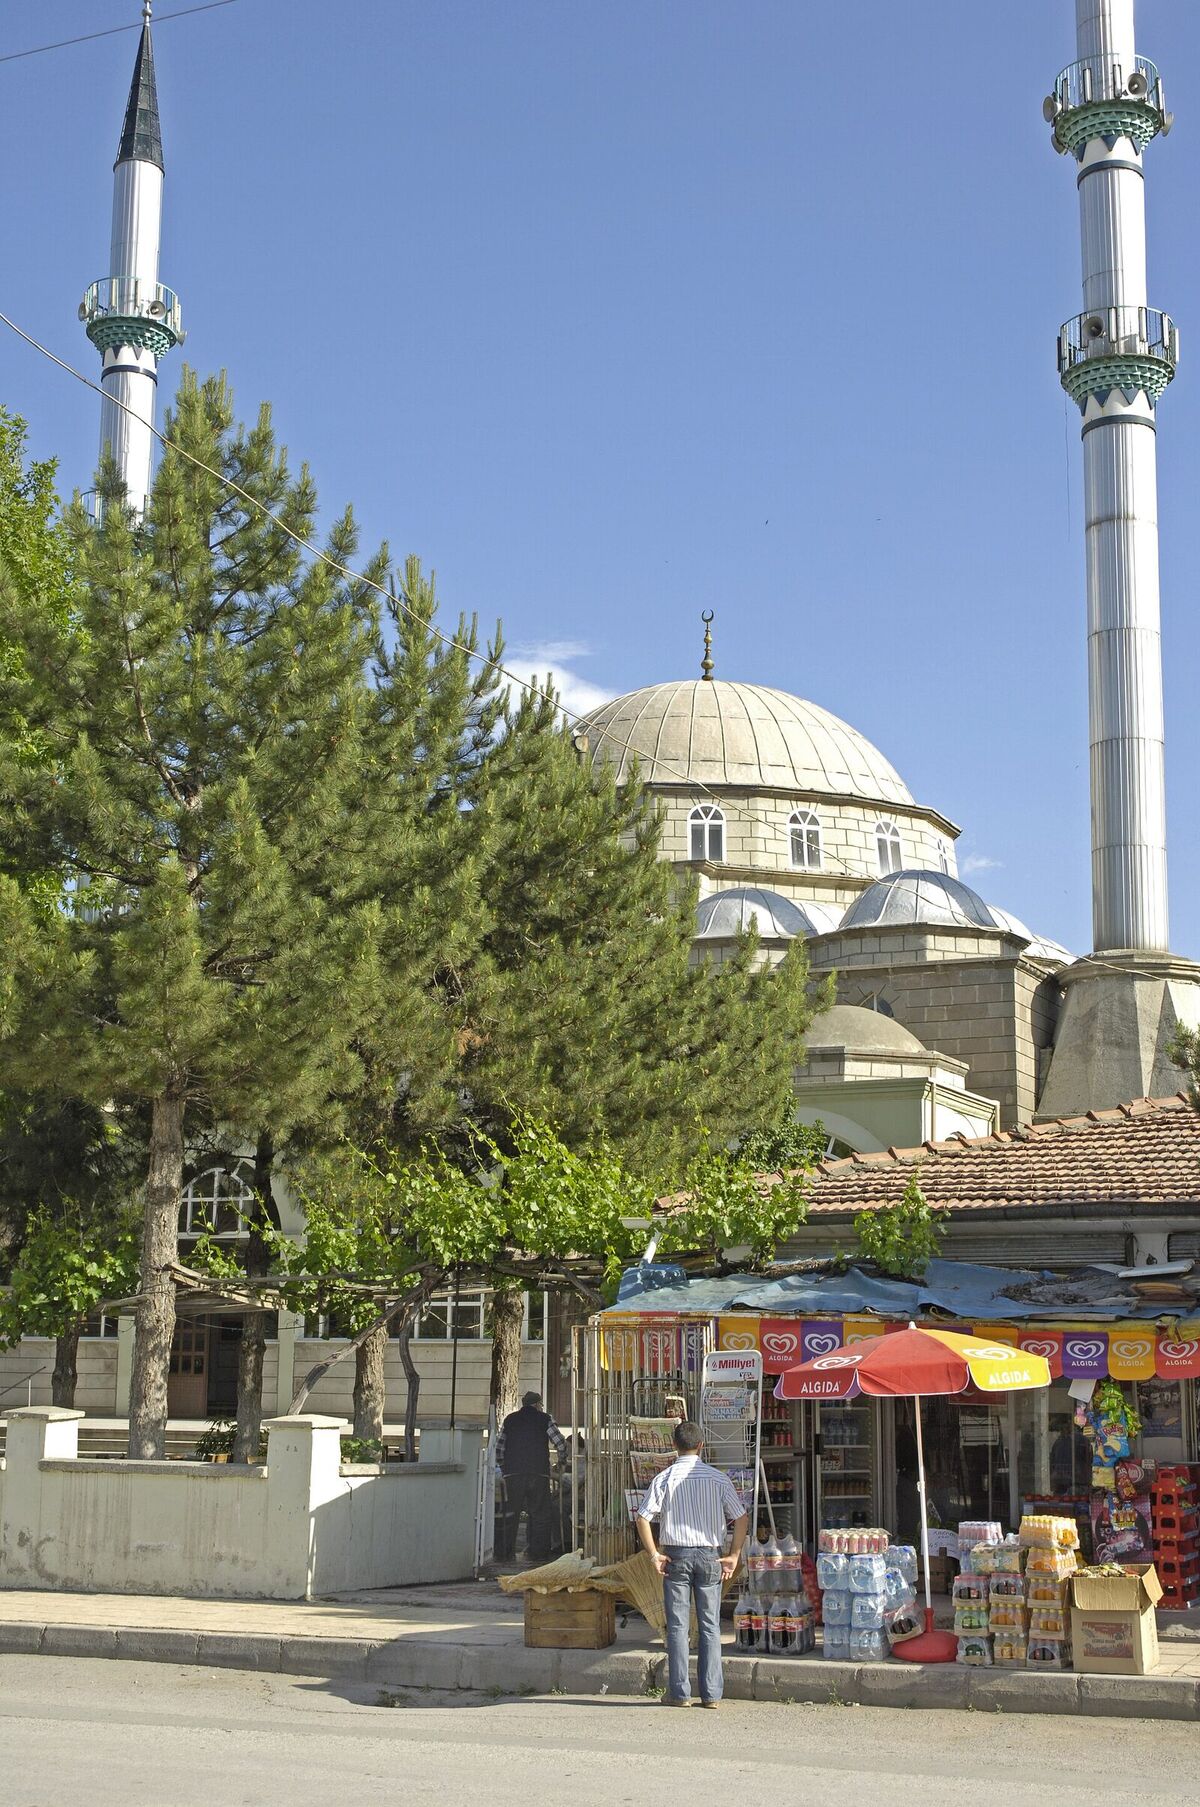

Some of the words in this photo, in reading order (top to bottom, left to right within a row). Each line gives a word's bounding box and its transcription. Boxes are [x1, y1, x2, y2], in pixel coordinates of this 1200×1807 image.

[718, 1359, 755, 1370] Milliyet
[988, 1369, 1031, 1385] ALGIDA
[800, 1381, 840, 1394] ALGIDA
